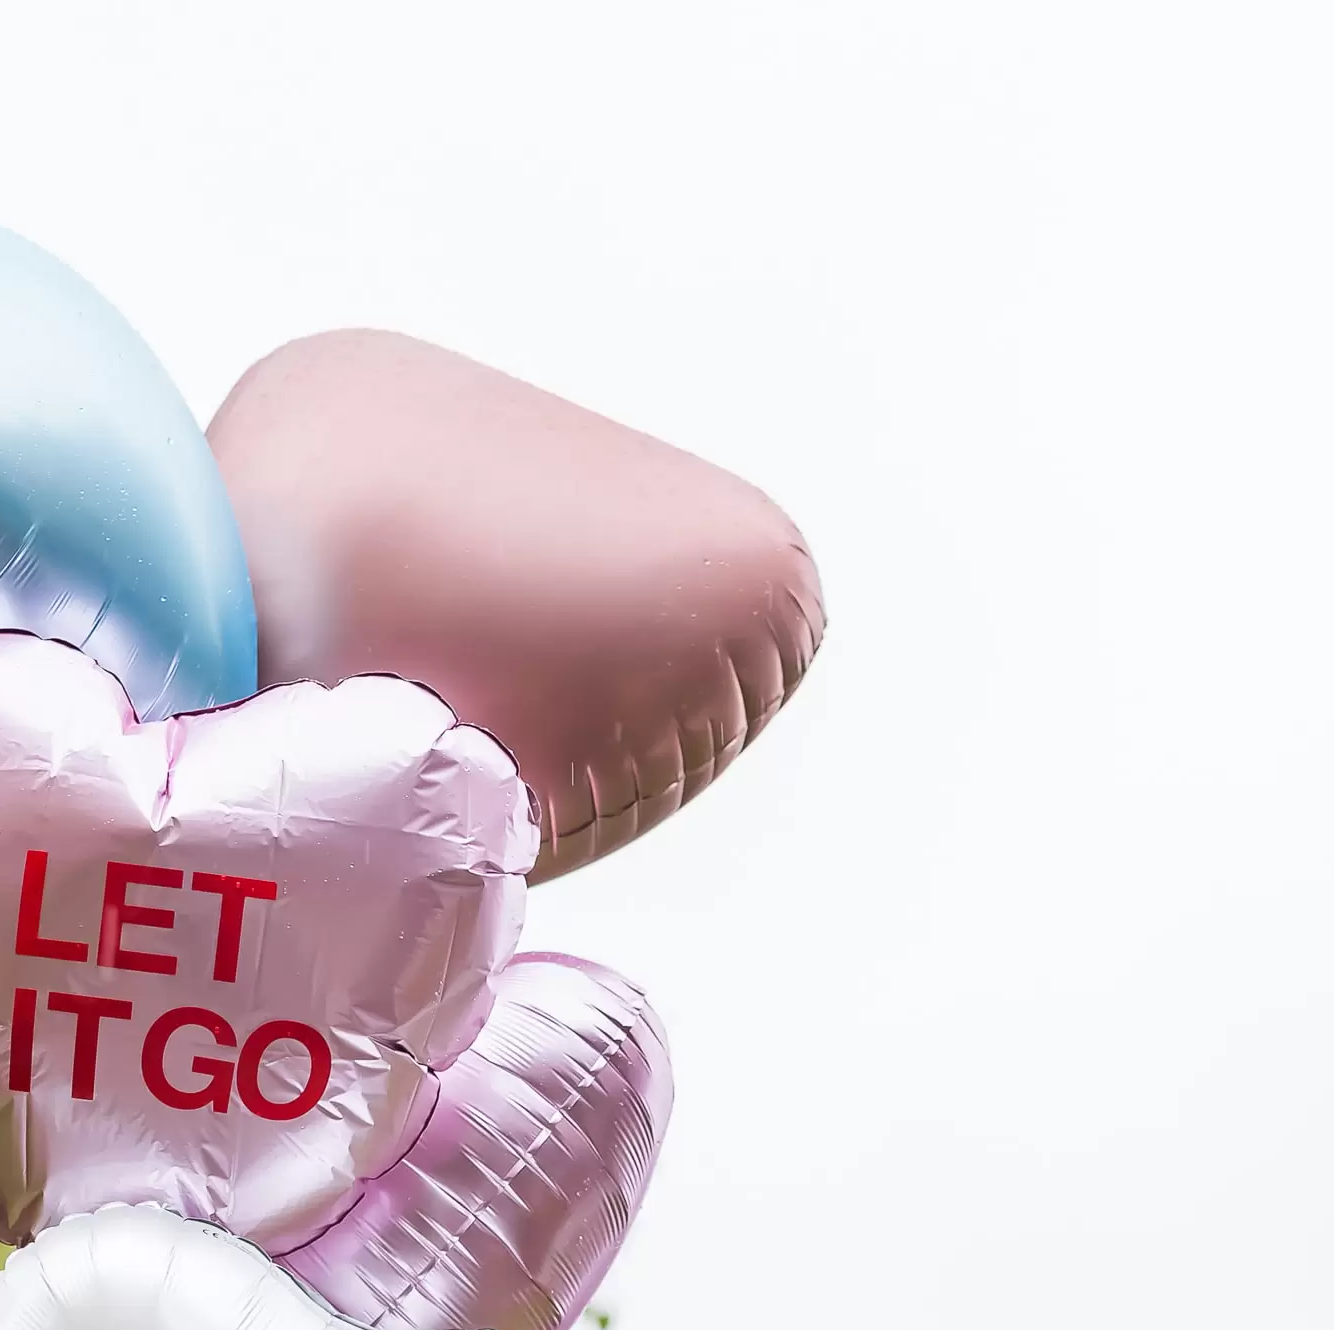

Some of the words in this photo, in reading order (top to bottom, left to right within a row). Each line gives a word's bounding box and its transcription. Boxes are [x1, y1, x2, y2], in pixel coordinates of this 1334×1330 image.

[14, 849, 278, 983] LET
[8, 987, 133, 1101] IT
[141, 1006, 332, 1121] GO
